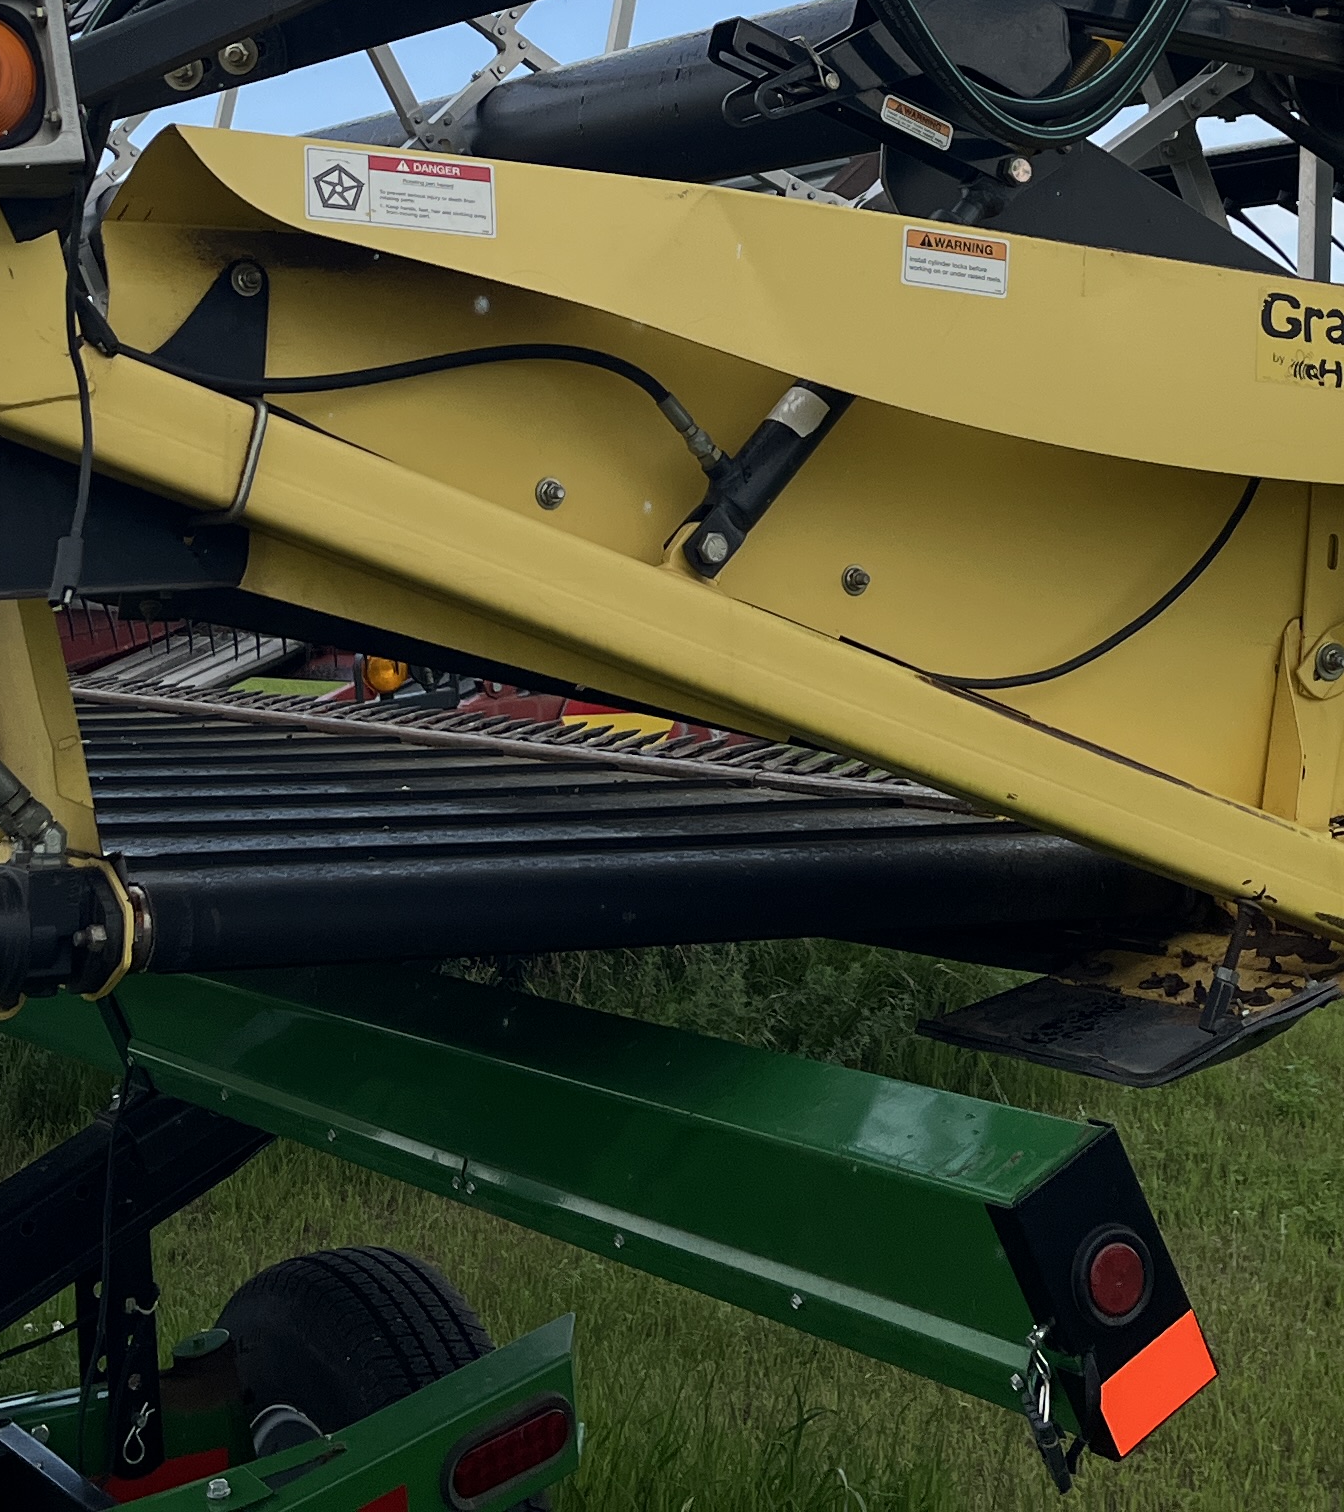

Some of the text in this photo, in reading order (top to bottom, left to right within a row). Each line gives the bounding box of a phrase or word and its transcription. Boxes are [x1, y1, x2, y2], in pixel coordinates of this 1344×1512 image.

[905, 107, 942, 133] WARNING
[413, 162, 461, 177] DANGER
[934, 236, 994, 256] WARNING
[909, 265, 932, 274] working
[928, 259, 951, 267] cylinder
[952, 262, 968, 270] locks
[968, 264, 988, 273] before
